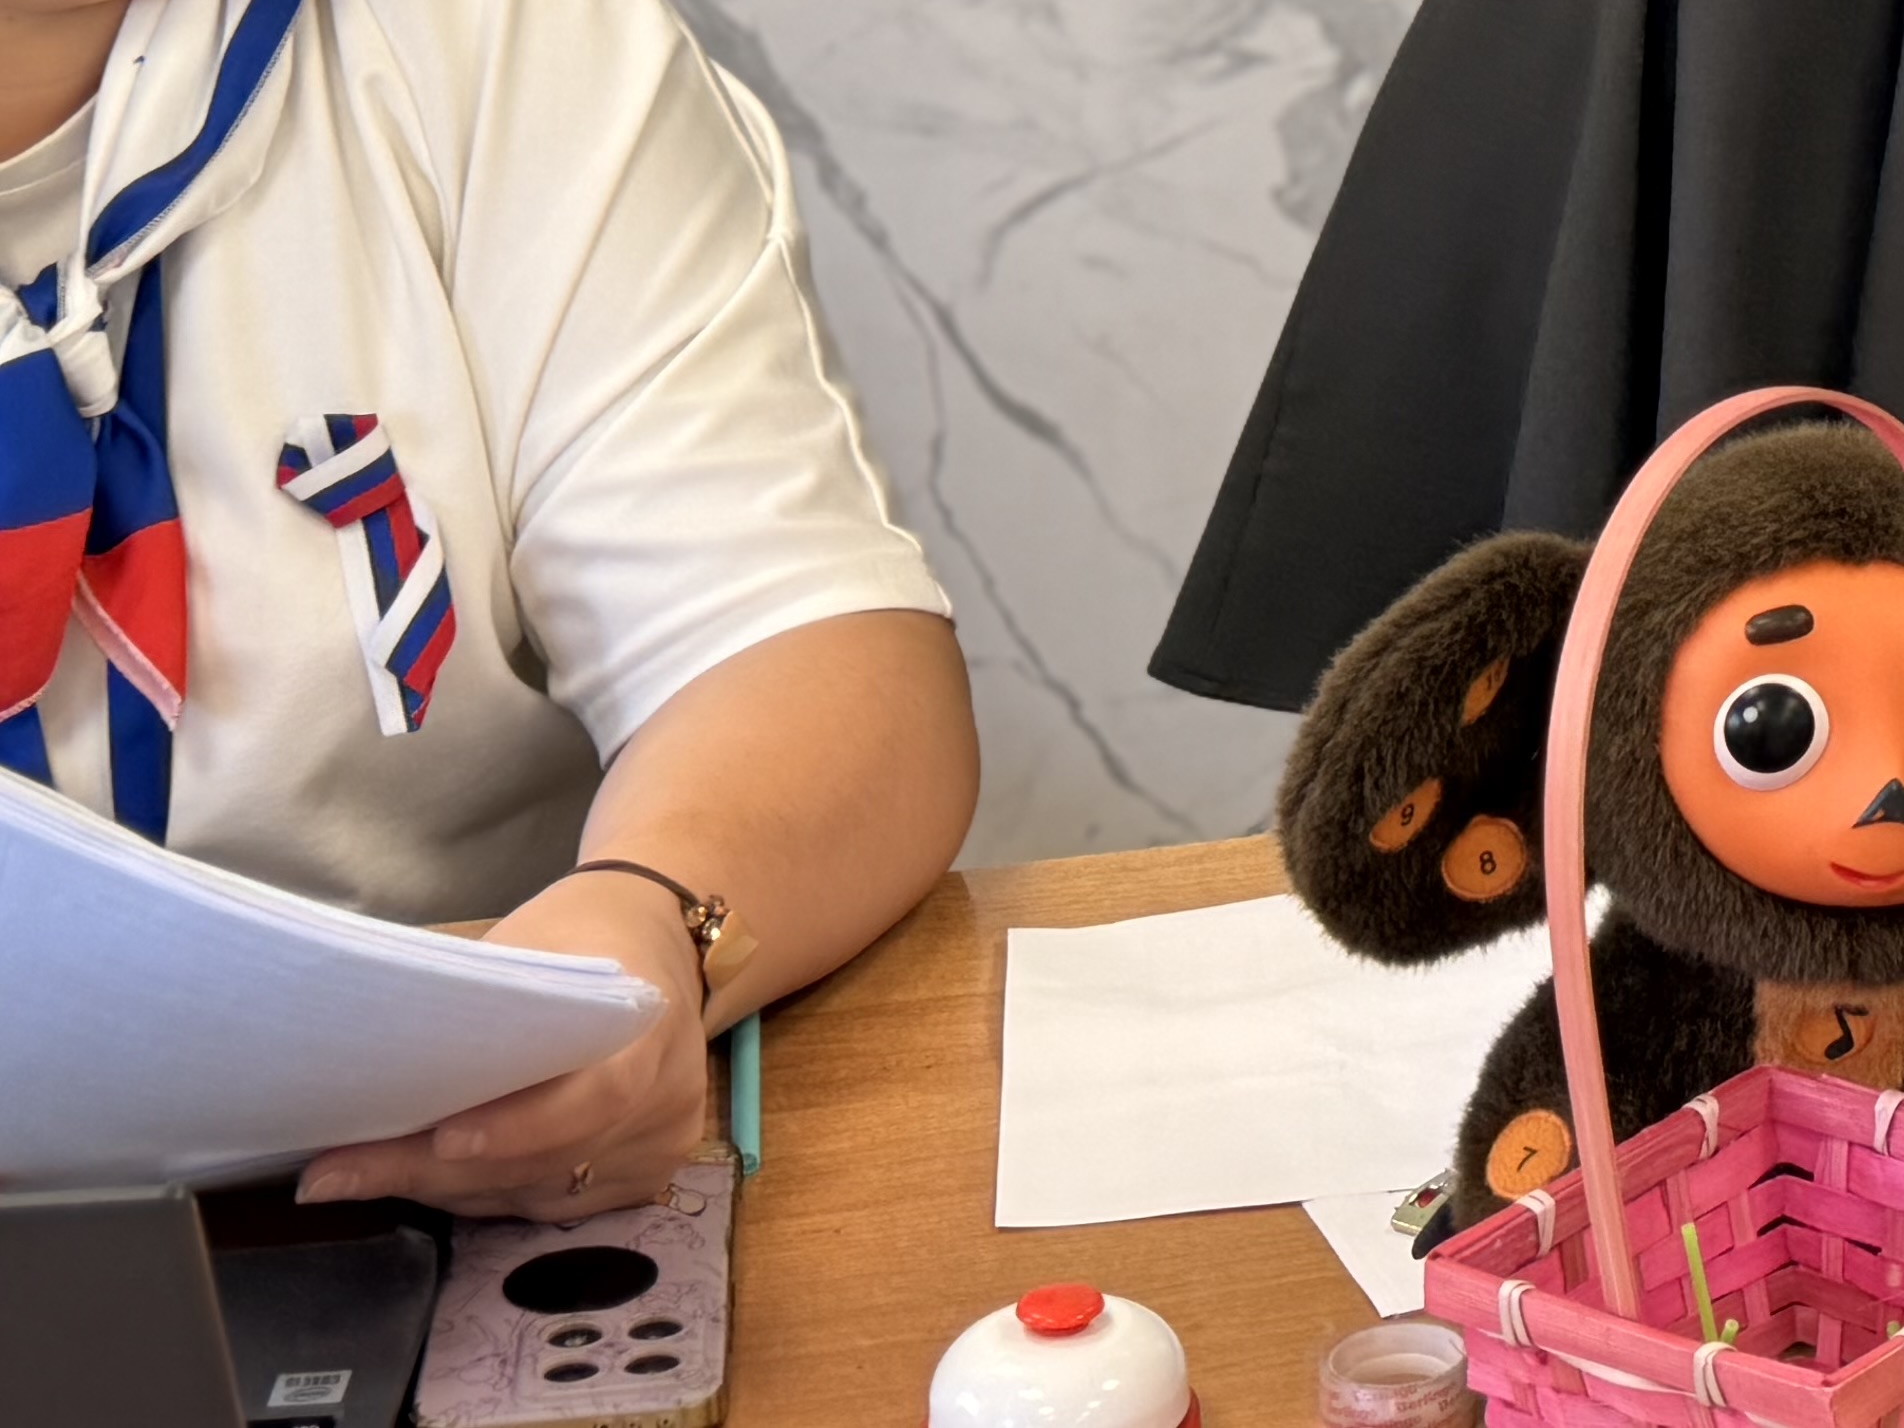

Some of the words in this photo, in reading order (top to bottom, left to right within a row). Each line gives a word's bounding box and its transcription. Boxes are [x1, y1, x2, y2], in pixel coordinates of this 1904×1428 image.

[1400, 803, 1415, 827] 9
[1479, 850, 1497, 876] 8
[1515, 1147, 1538, 1173] 7
